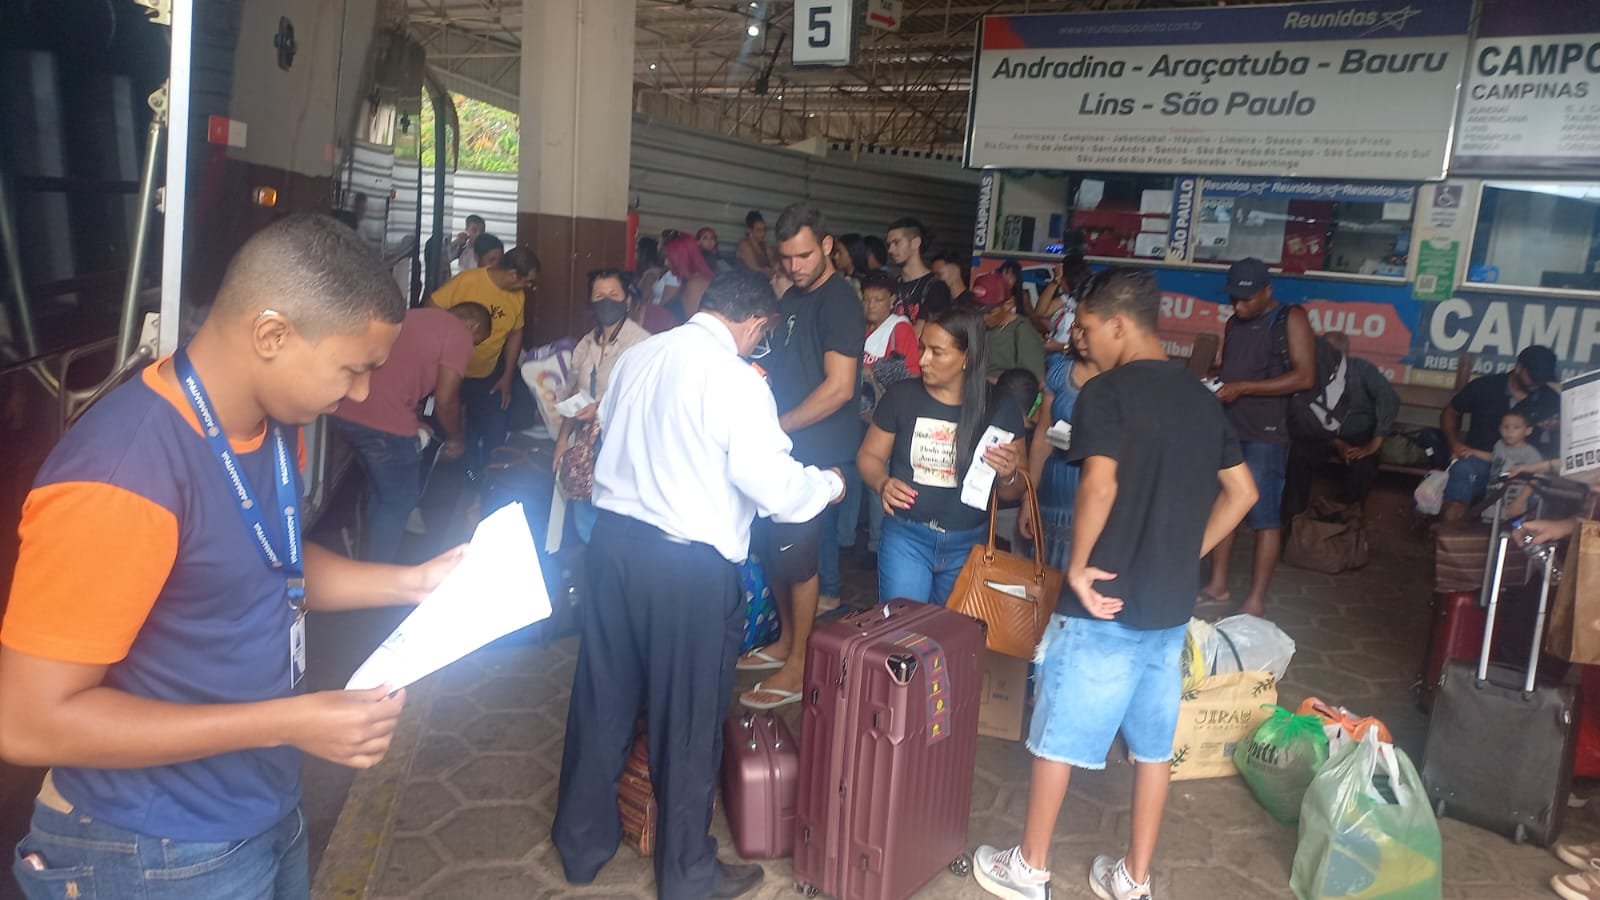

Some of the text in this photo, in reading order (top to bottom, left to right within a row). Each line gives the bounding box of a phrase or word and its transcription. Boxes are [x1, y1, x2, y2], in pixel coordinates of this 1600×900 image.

[808, 6, 832, 48] 5
[1284, 9, 1378, 30] Reunidas
[992, 55, 1125, 79] Andradina
[1148, 50, 1310, 84] Araçatuba
[1338, 49, 1448, 74] Bauru
[1078, 92, 1135, 116] Lins
[1160, 91, 1219, 116] São
[1224, 89, 1316, 116] Paulo
[1471, 81, 1590, 101] CAMPINAS
[1204, 179, 1250, 192] Reunidas
[1271, 181, 1321, 195] Reunidas
[1342, 183, 1395, 197] Reunidas
[974, 175, 993, 247] CAMPINAS
[1171, 180, 1194, 259] SÃO PAULO
[1308, 308, 1386, 338] AULO
[1424, 354, 1494, 374] RIBEÃO
